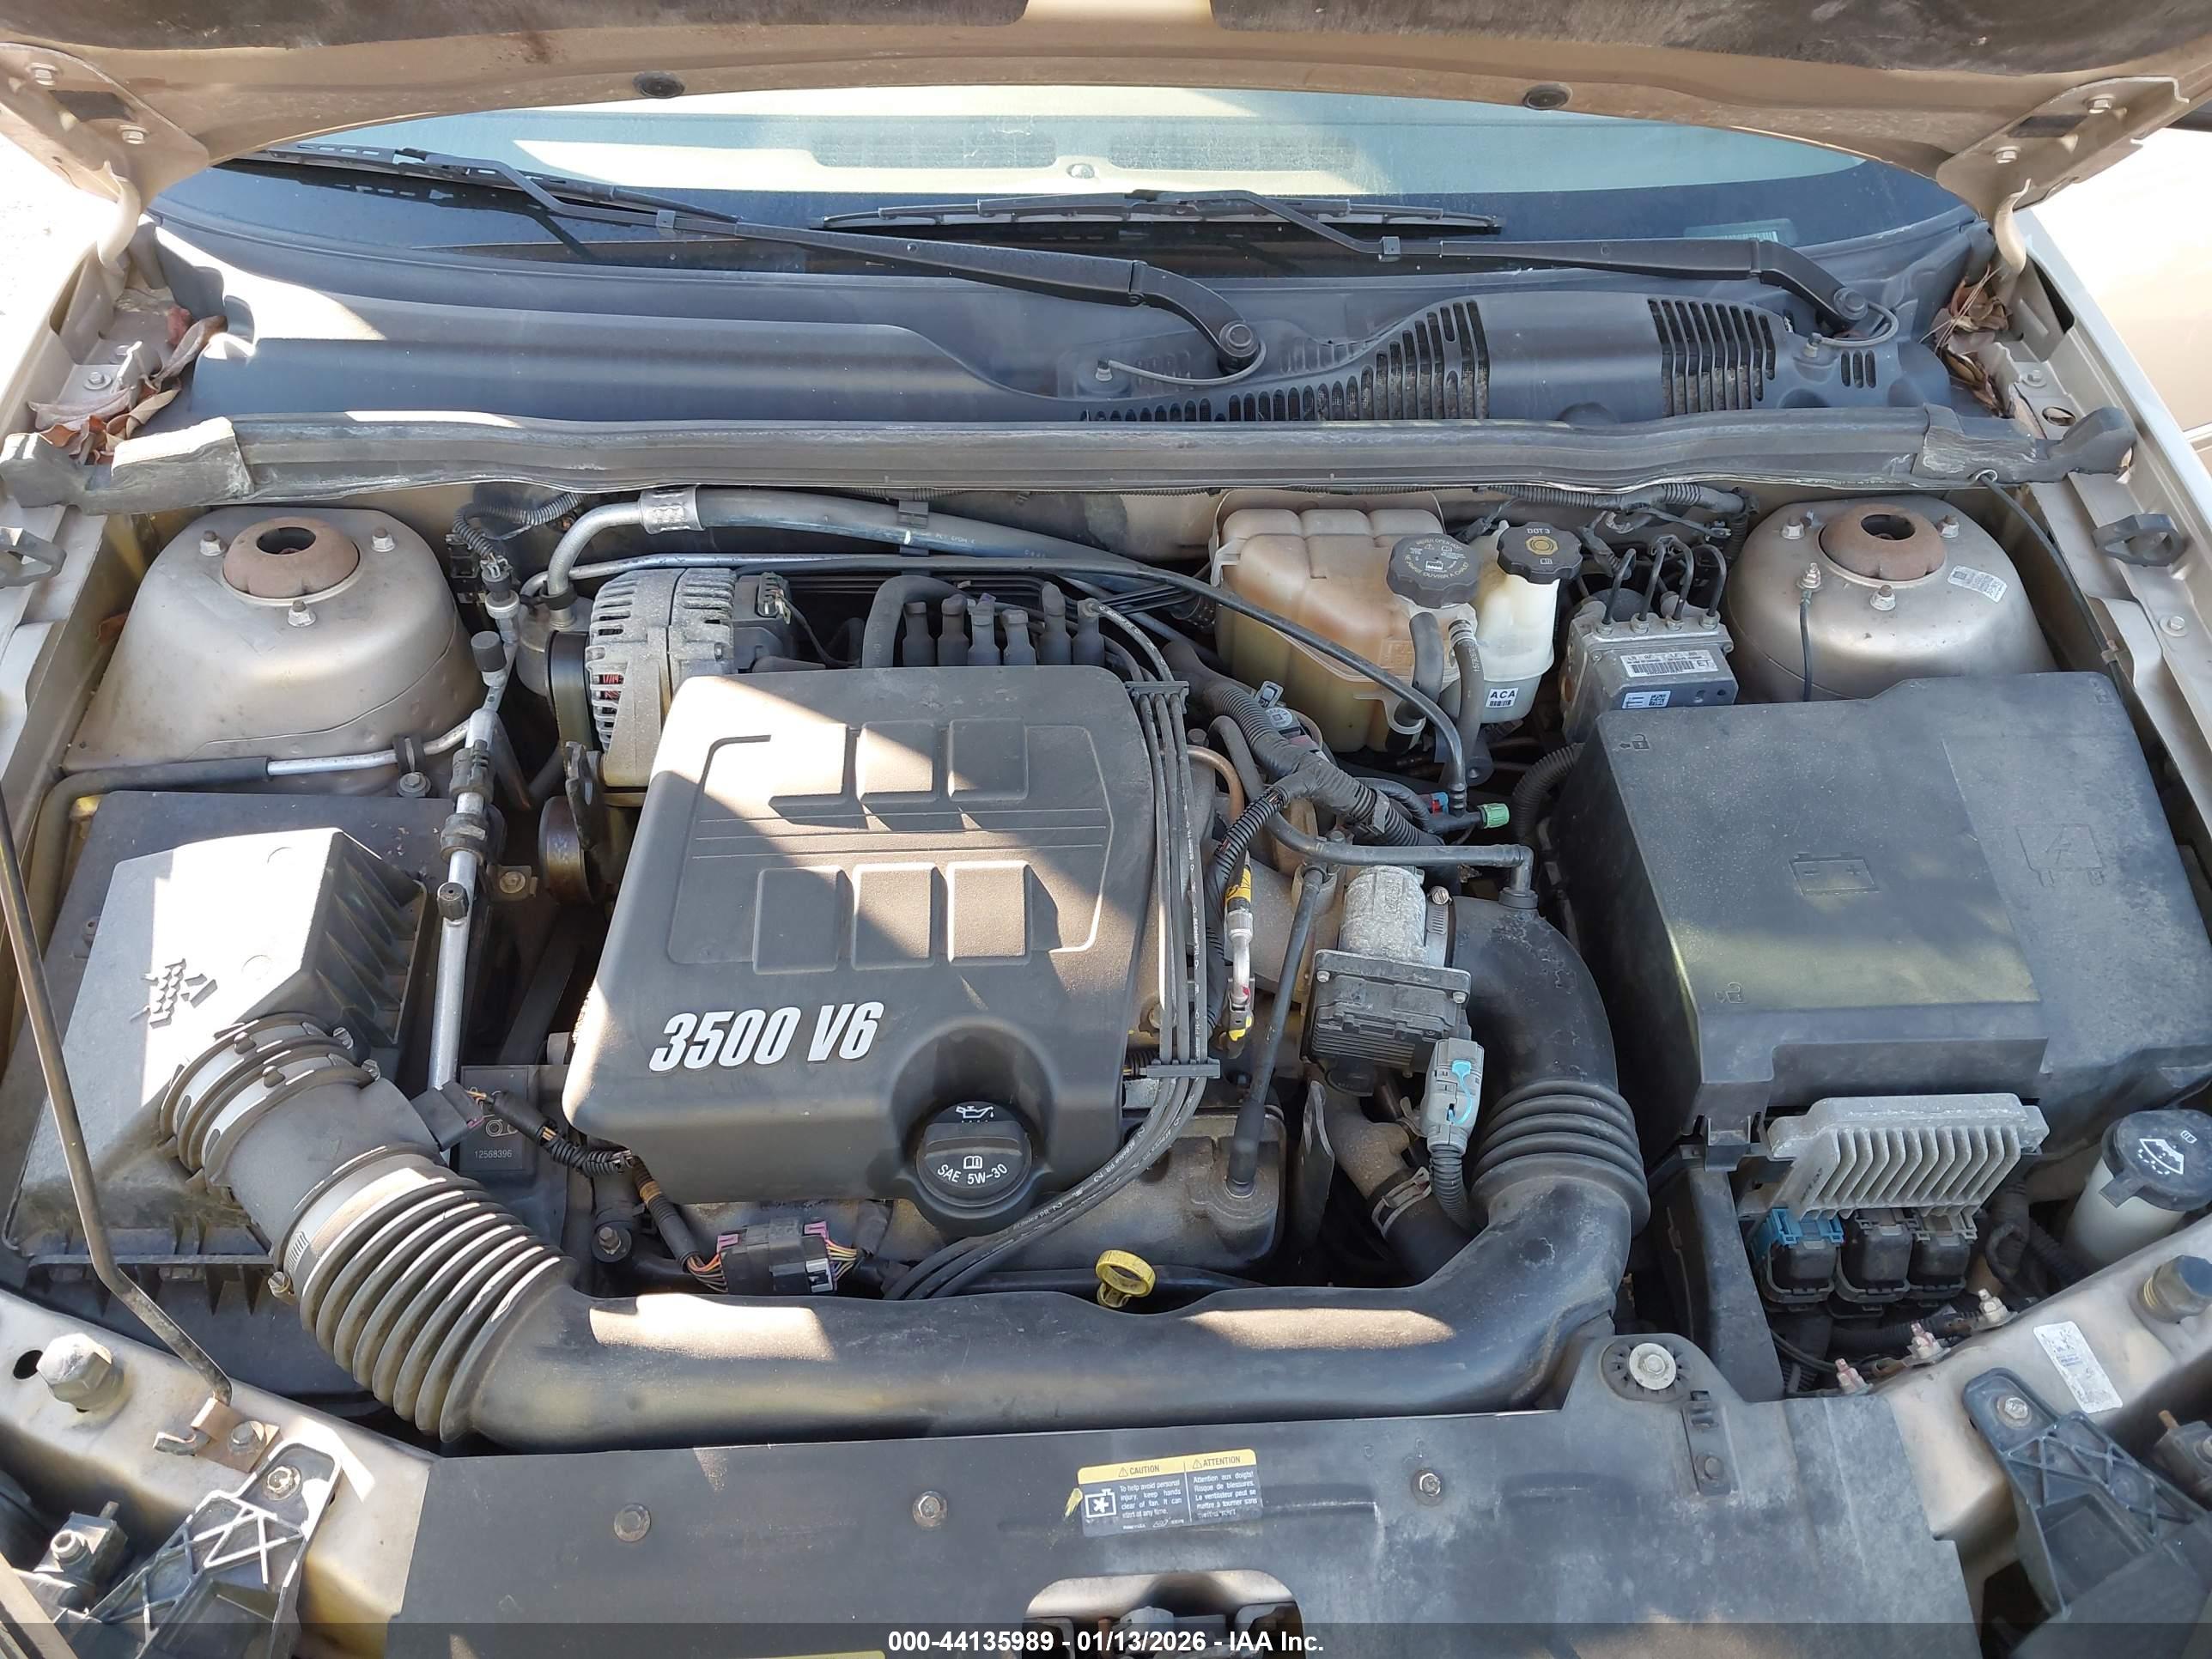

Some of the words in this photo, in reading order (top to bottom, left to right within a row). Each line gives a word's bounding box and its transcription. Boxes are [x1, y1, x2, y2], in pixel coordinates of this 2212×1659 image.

[1491, 690, 1516, 699] ACA
[649, 1006, 802, 1072] 3500
[807, 1001, 884, 1062] V6
[474, 1150, 513, 1158] 12568396
[937, 1164, 962, 1182] SAE
[967, 1164, 1008, 1185] 5W-30
[1203, 1456, 1241, 1468] ATTENTION
[1129, 1464, 1160, 1475] CAUTION
[1194, 1474, 1218, 1484] Attention
[1127, 1485, 1139, 1493] help
[1156, 1480, 1181, 1491] personal
[1194, 1483, 1214, 1492] Risque
[1205, 1491, 1233, 1499] ventilateur
